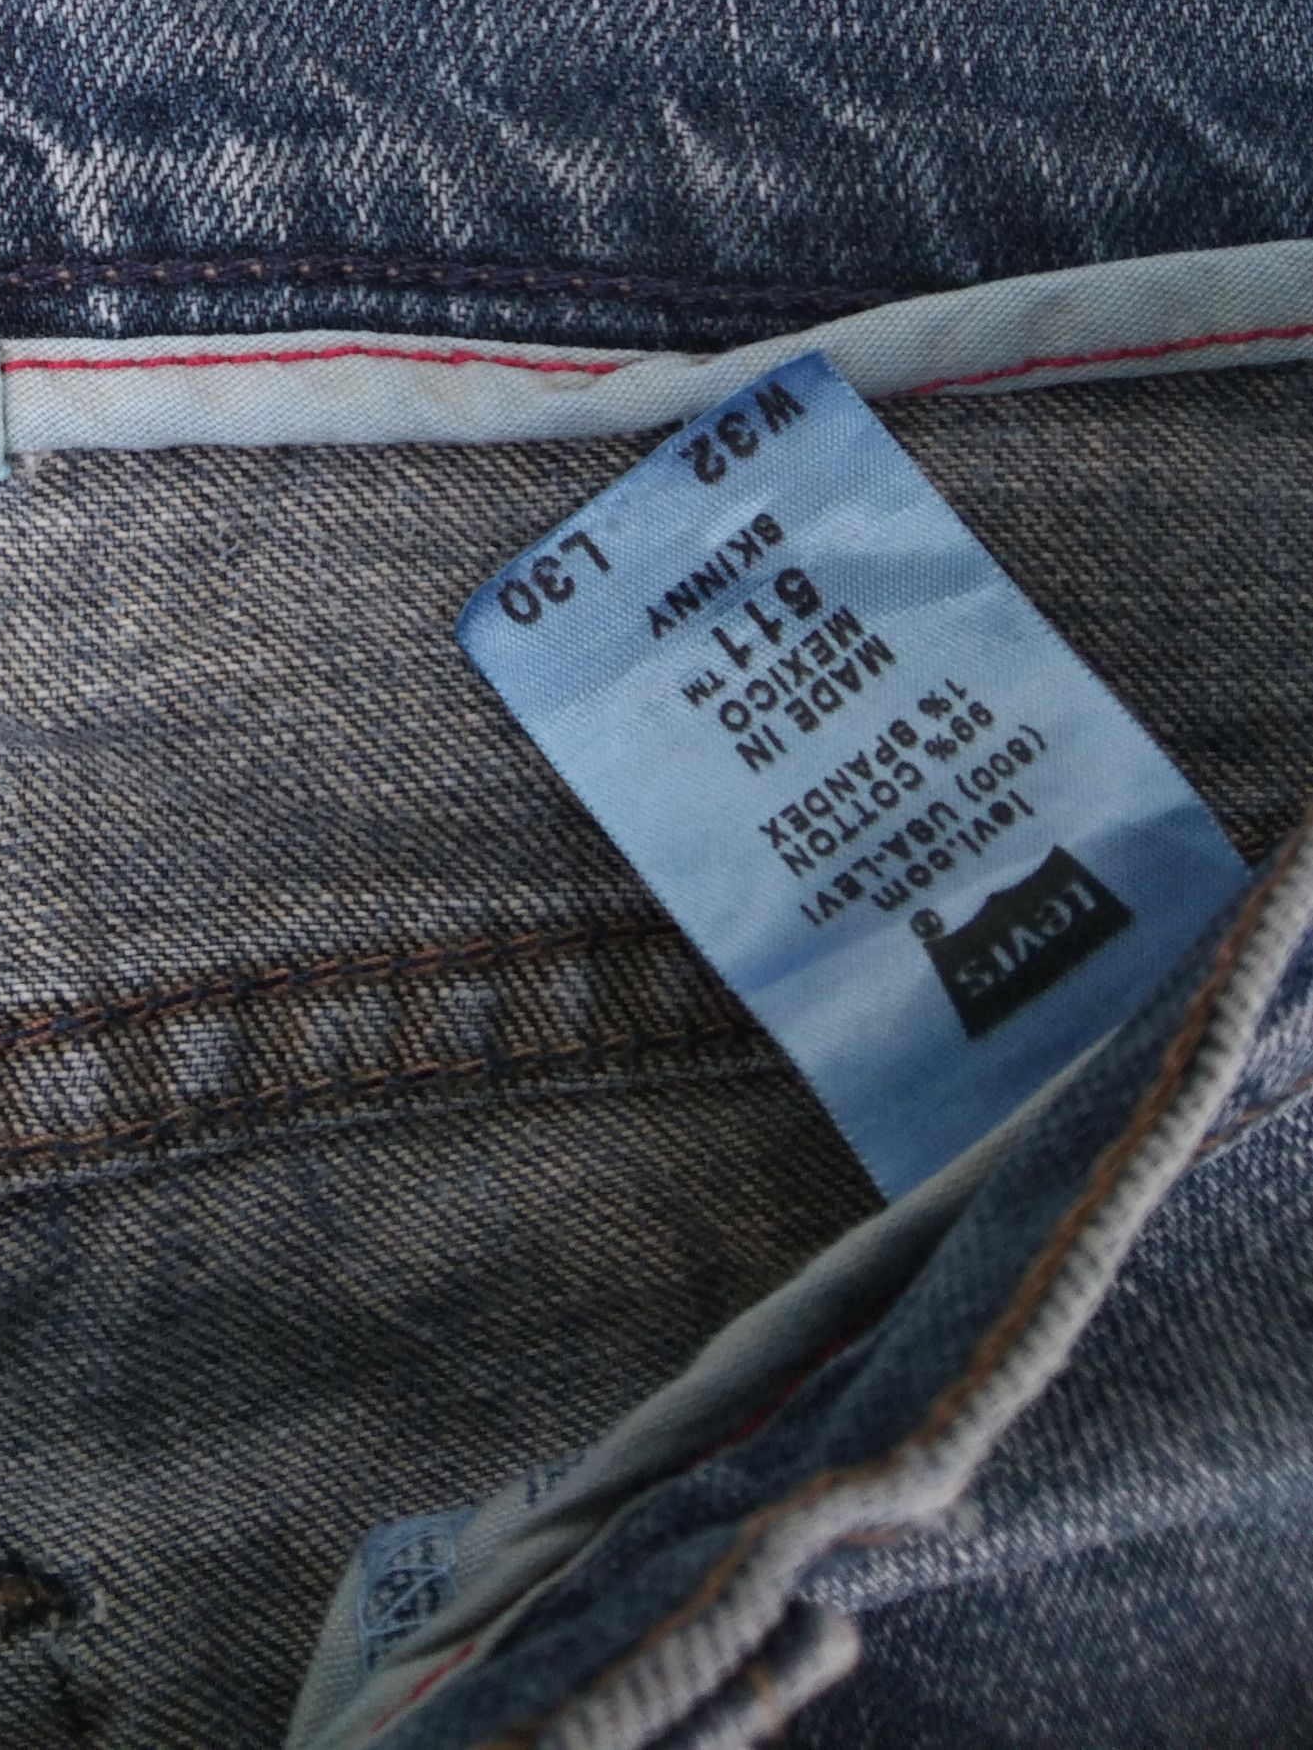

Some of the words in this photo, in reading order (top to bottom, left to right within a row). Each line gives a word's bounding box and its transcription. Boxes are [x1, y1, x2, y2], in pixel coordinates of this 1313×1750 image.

[497, 531, 611, 625] L30
[646, 514, 784, 639] SKINNY
[719, 606, 865, 733] MEXICO
[784, 634, 896, 734] MADE
[918, 677, 968, 720] 1%
[735, 724, 788, 773] IN
[759, 719, 919, 850] SPANDEX
[923, 701, 995, 760] 99%
[955, 723, 1049, 802] (800)
[780, 761, 924, 878] COTTON
[799, 800, 960, 926] USA-LEVI
[871, 790, 1035, 912] levi.com
